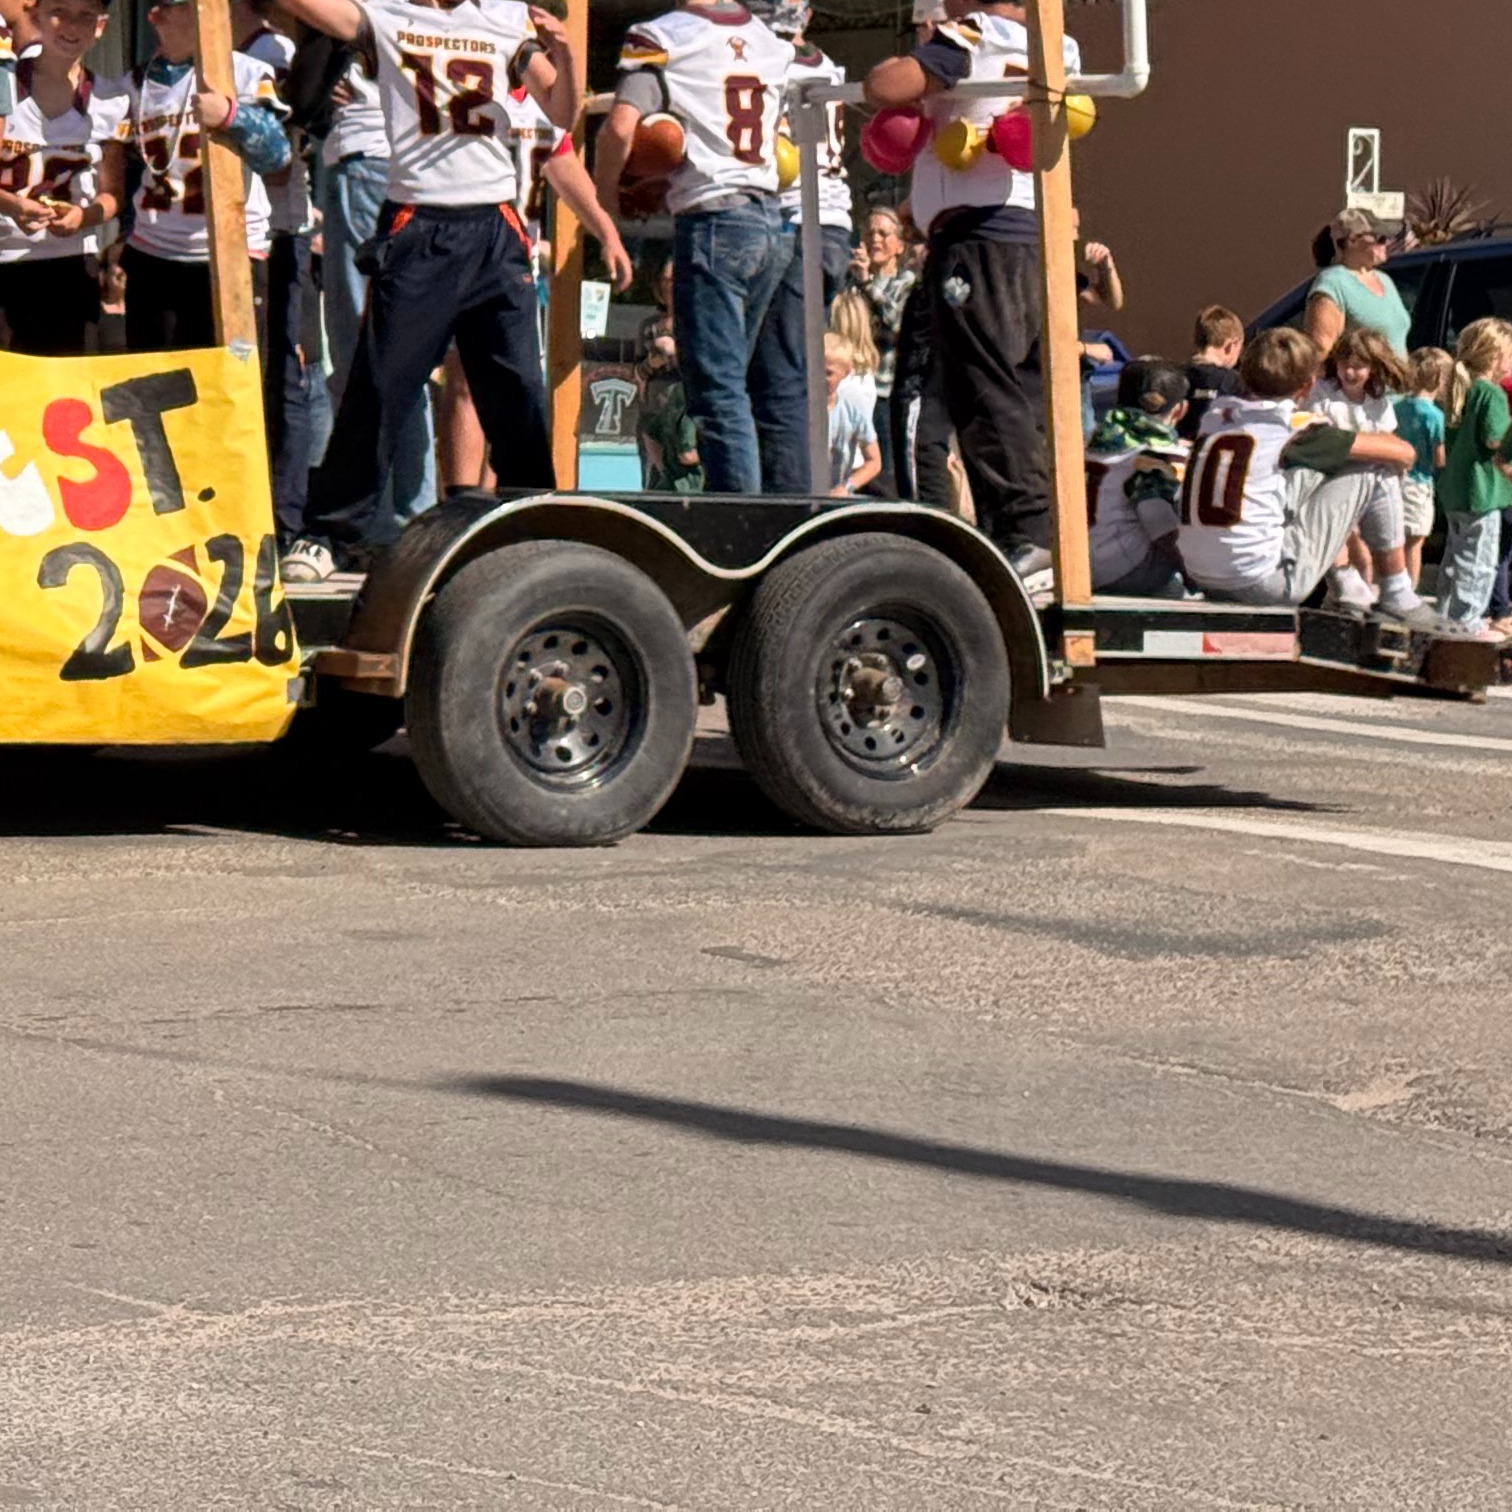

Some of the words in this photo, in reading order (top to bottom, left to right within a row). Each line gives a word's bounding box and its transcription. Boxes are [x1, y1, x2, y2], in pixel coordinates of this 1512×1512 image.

[396, 31, 496, 54] PROSPECTORS
[399, 51, 496, 136] 12
[724, 74, 768, 165] 8
[37, 533, 294, 682] 2026
